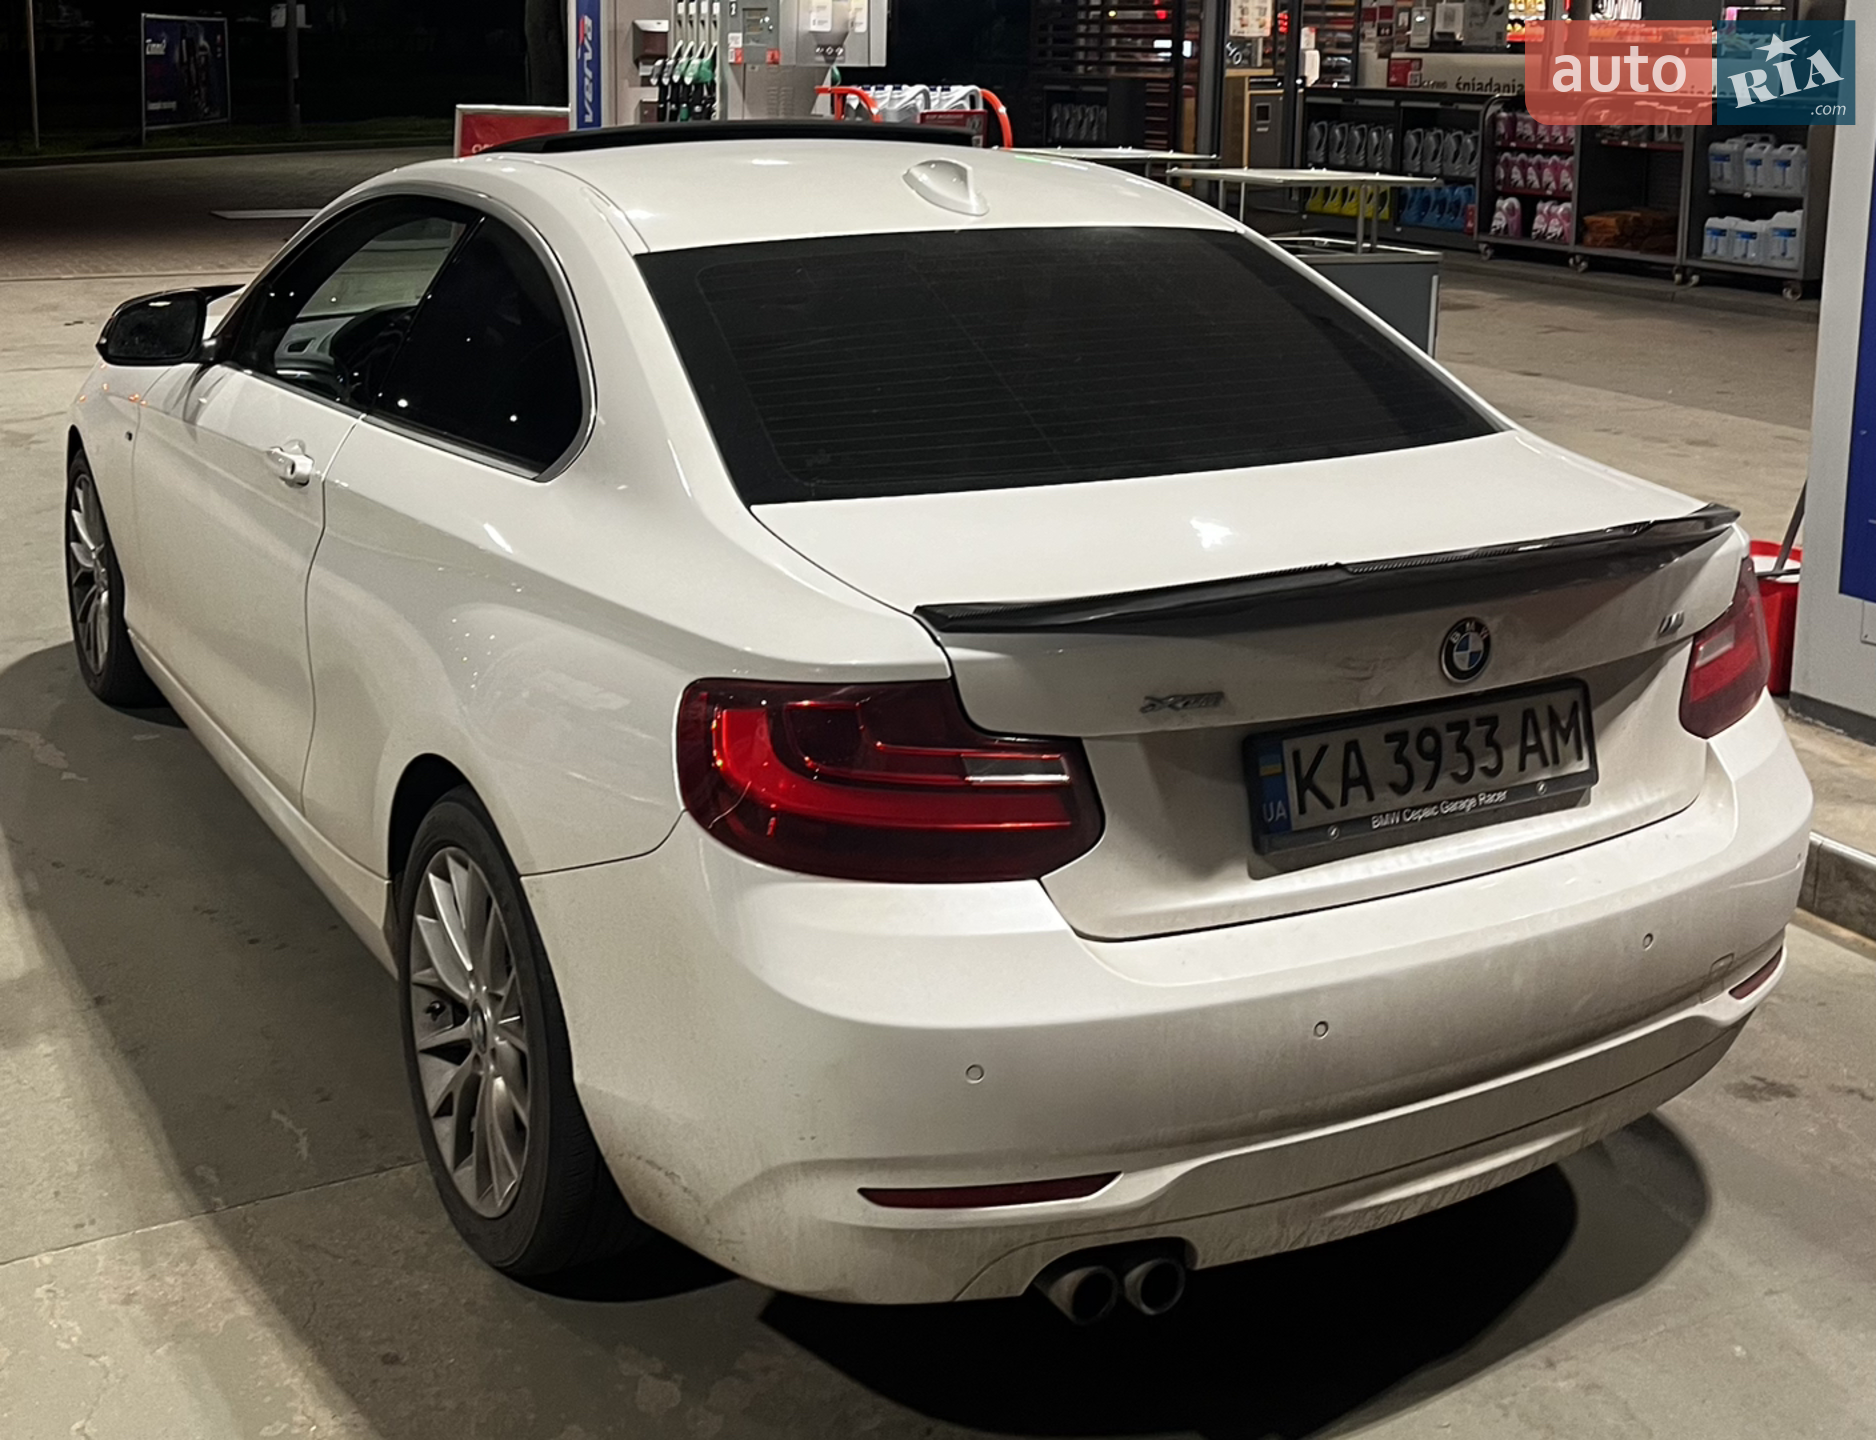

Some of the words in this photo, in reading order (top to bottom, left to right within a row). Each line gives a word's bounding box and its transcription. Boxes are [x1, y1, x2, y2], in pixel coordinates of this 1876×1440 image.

[1292, 738, 1376, 816] KA
[1384, 714, 1504, 796] 3933
[1518, 700, 1584, 773] AM
[1262, 800, 1288, 824] UA
[1371, 813, 1400, 829] BMW
